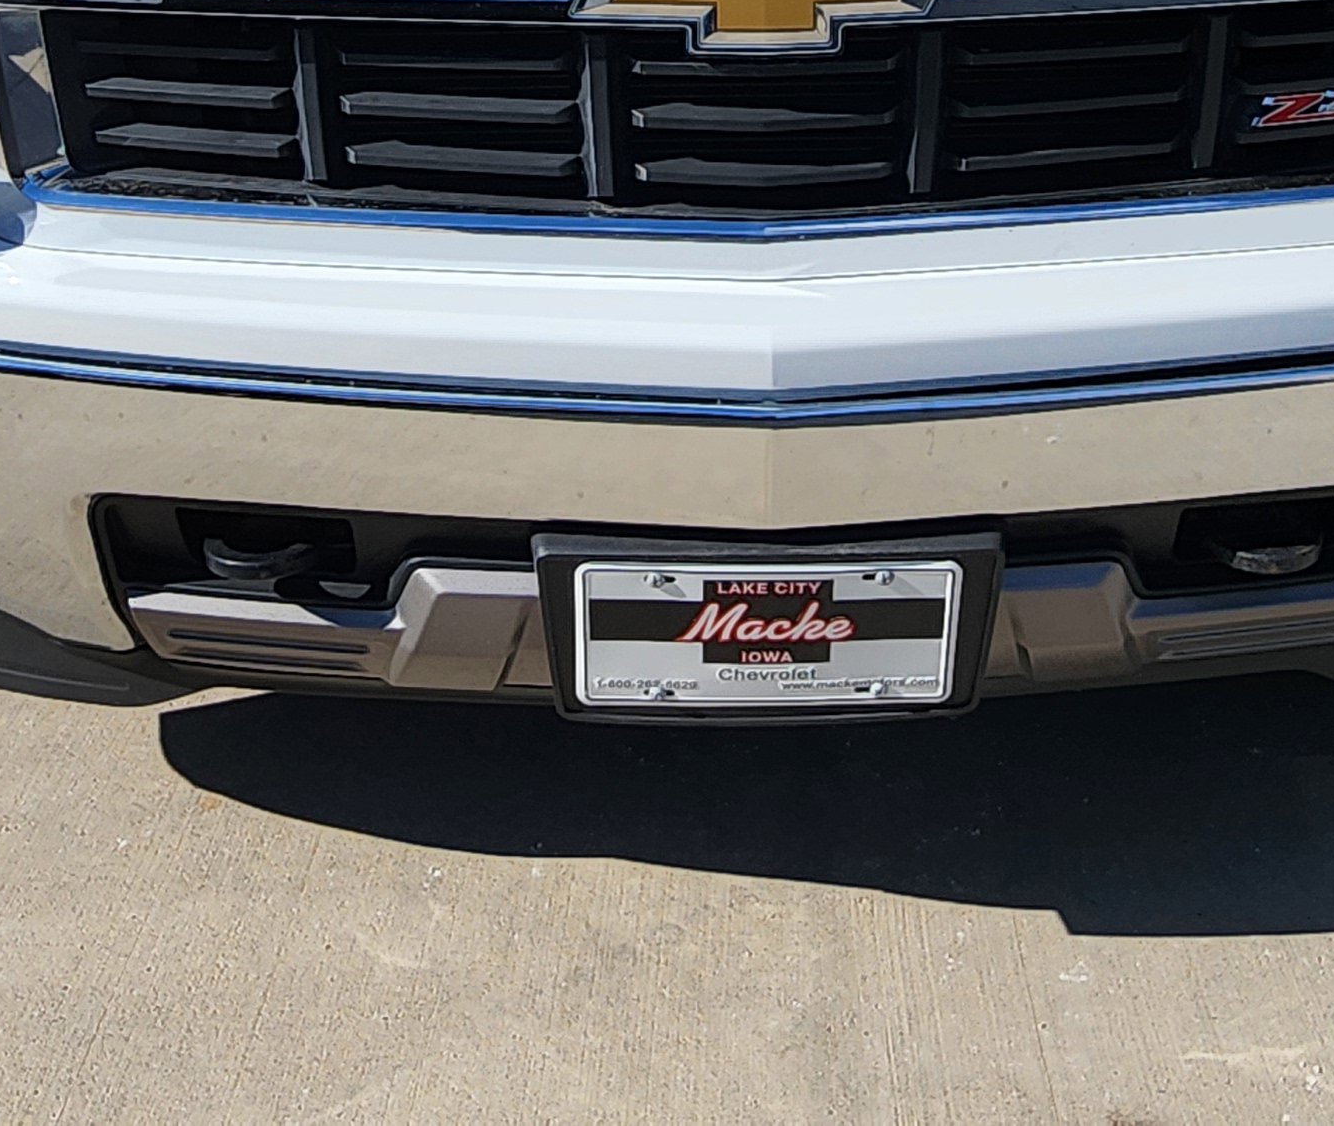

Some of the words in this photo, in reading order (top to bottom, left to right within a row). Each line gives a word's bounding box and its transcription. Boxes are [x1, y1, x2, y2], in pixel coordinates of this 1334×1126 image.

[717, 581, 768, 595] LAKE
[774, 581, 822, 595] CITY
[677, 601, 854, 642] Macke
[740, 650, 794, 664] IOWA
[718, 667, 817, 681] Chevrolet
